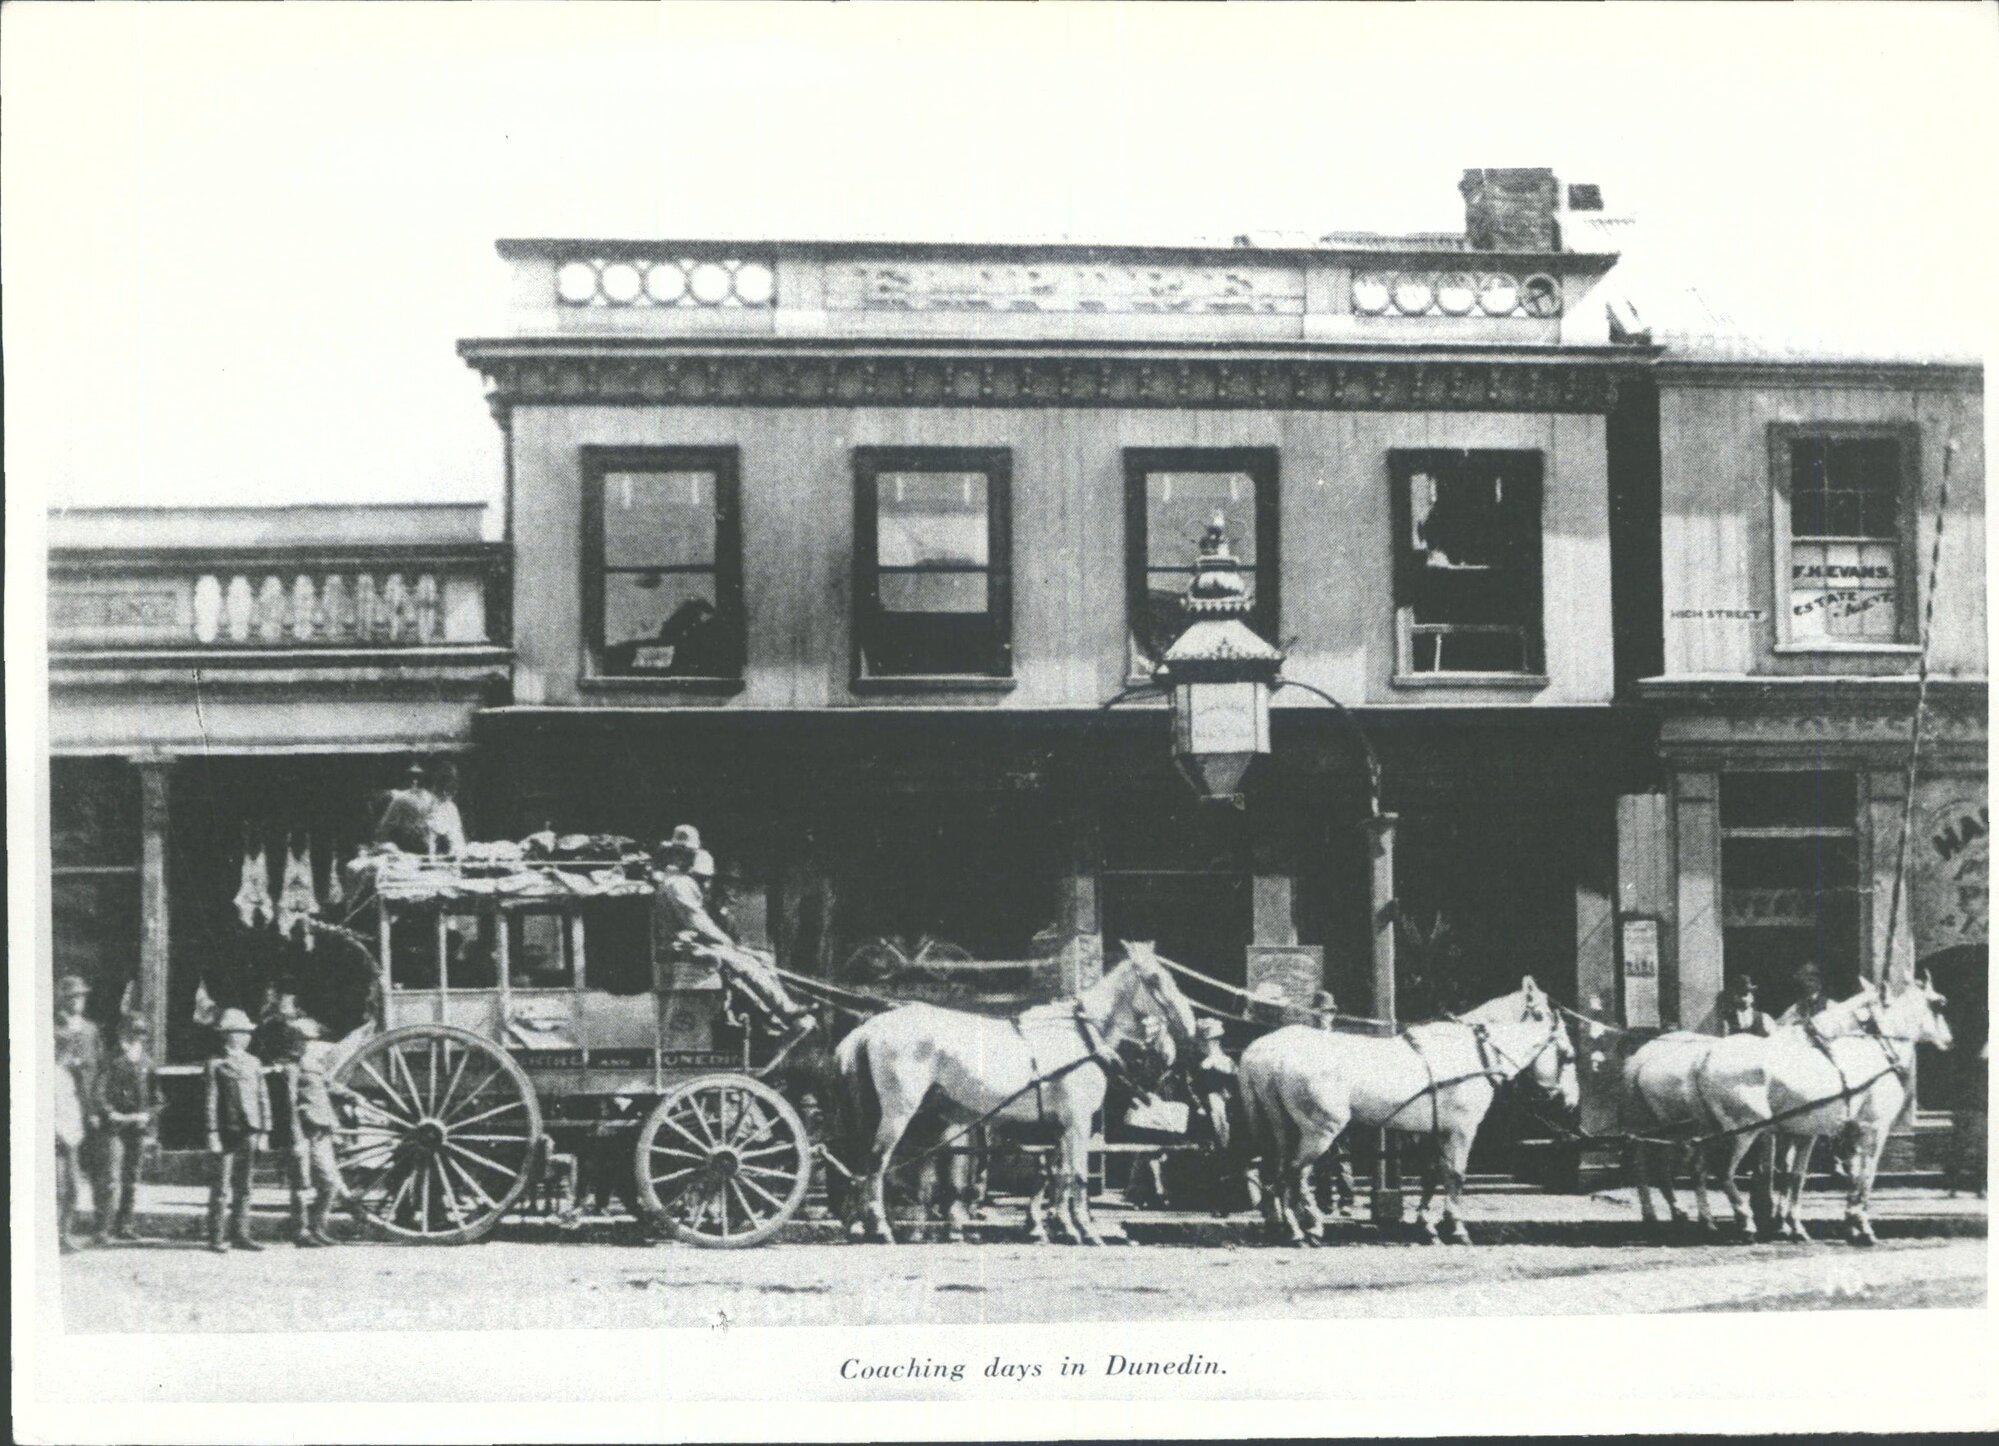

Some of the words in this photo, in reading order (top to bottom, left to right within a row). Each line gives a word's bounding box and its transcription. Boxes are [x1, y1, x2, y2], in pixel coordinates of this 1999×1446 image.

[1793, 591, 1857, 616] ESTATE
[1670, 609, 1703, 619] HIGH
[1706, 609, 1762, 620] STREET
[600, 1058, 631, 1067] AND
